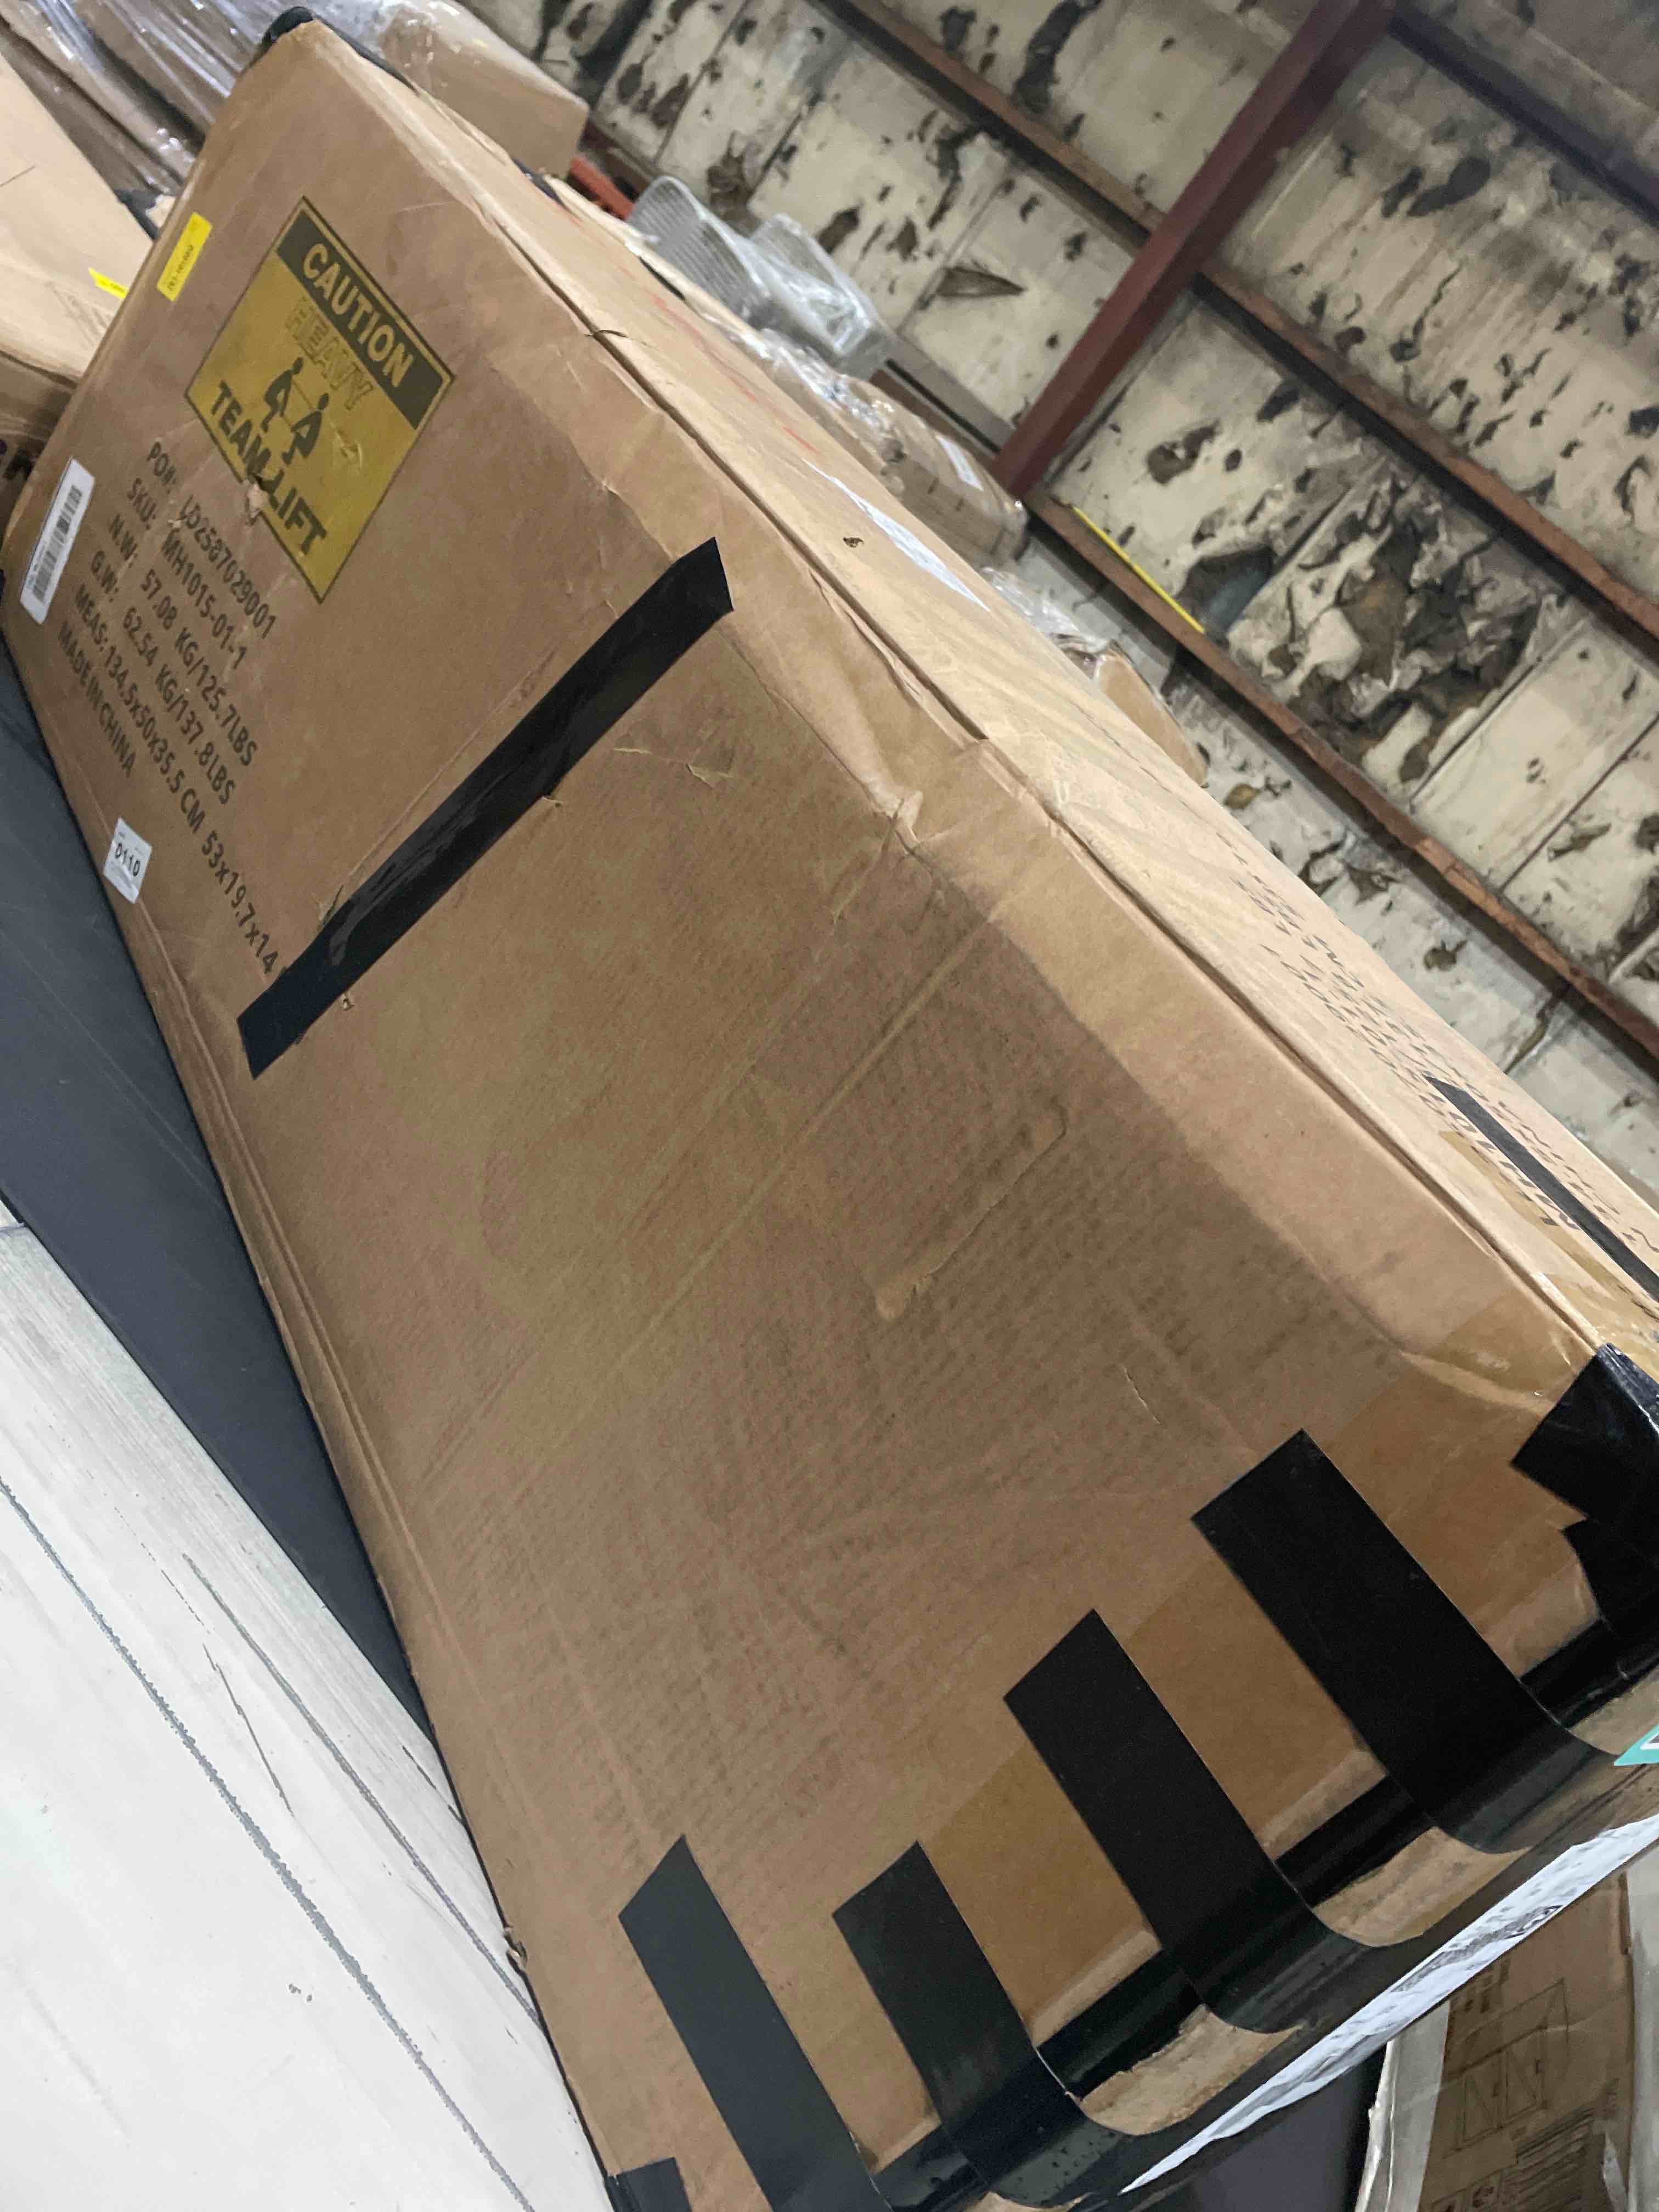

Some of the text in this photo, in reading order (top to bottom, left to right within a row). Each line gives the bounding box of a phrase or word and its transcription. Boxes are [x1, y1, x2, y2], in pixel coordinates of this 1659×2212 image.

[285, 296, 374, 410] HEAVY
[303, 243, 414, 387] CAUTION
[211, 380, 328, 555] TEAM LIFT
[127, 478, 247, 669] SKU: MH1015-01-1
[58, 620, 137, 778] MADE IN CHINA
[123, 606, 160, 667] 62.54
[155, 663, 236, 805] KG/137.8LBS
[141, 568, 178, 630] 57.08
[174, 627, 258, 766] KG/125.7LBS
[74, 584, 109, 652] MEAS:
[180, 788, 206, 834] CM
[201, 830, 278, 975] 53x19.7x14
